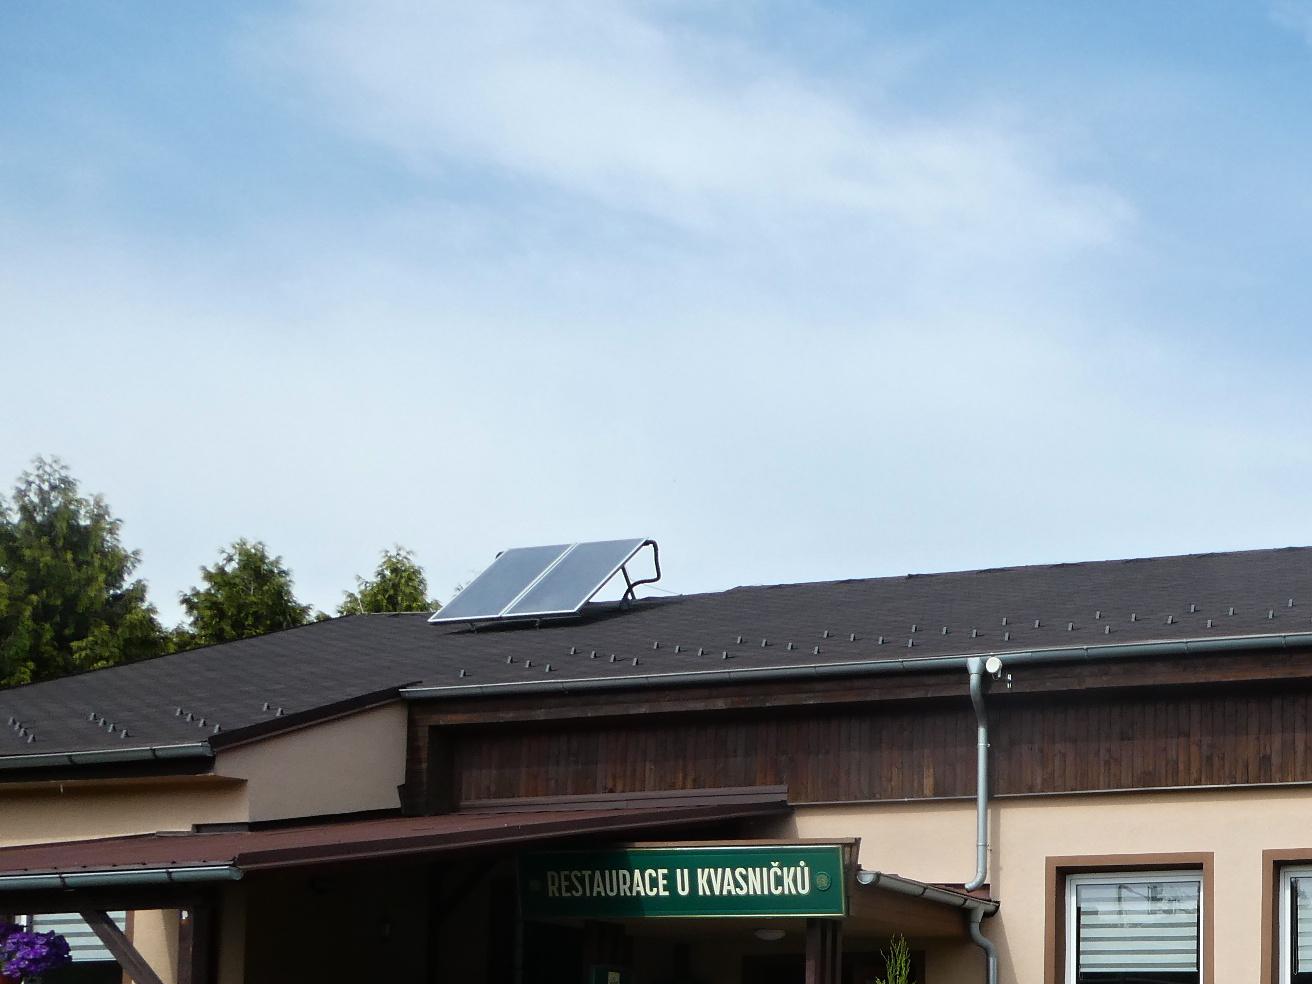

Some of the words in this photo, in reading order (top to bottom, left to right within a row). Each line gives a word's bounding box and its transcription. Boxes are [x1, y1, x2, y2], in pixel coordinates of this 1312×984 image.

[547, 868, 670, 896] RESTAURACE
[677, 868, 690, 896] U
[698, 861, 811, 896] KVASNIČKŮ
